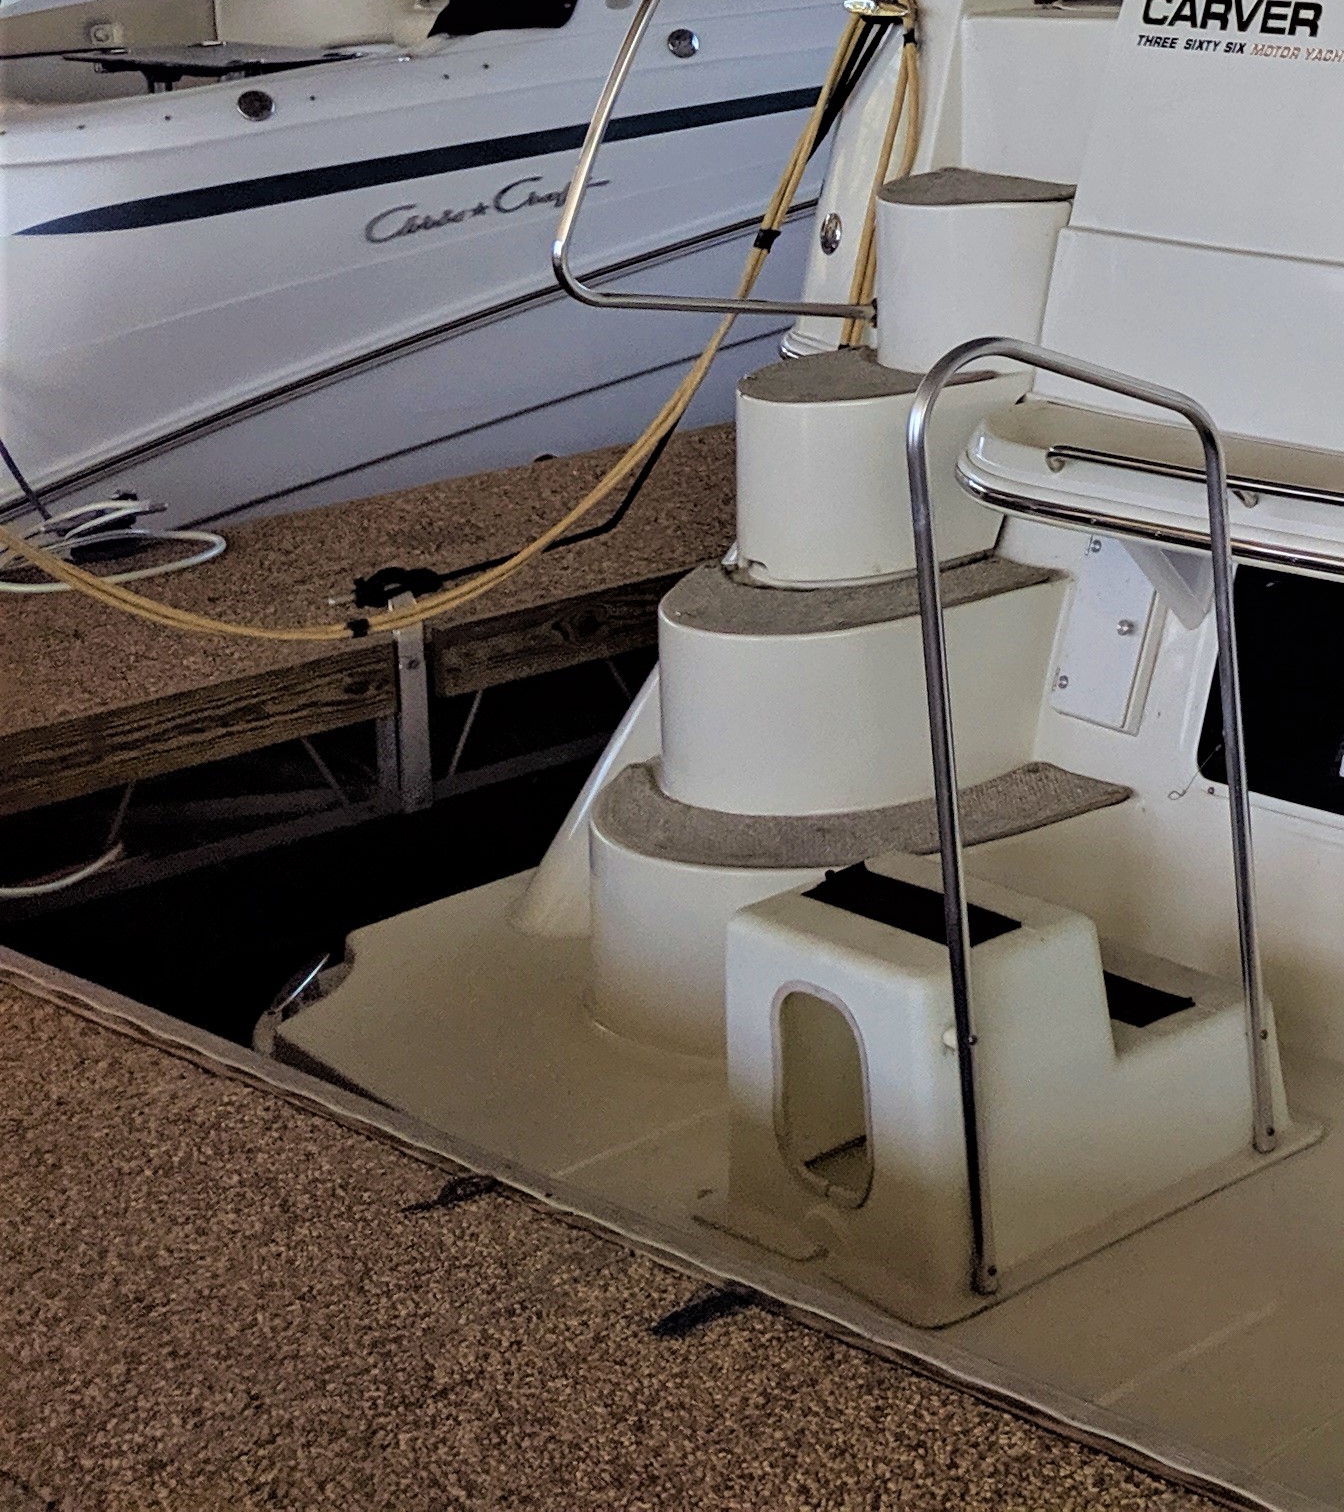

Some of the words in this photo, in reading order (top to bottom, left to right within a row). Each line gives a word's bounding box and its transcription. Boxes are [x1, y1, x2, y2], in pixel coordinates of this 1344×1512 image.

[1136, 35, 1179, 49] THREE
[1183, 38, 1221, 52] SIXTY
[1223, 42, 1247, 54] SIX
[1250, 43, 1300, 59] MOTOR
